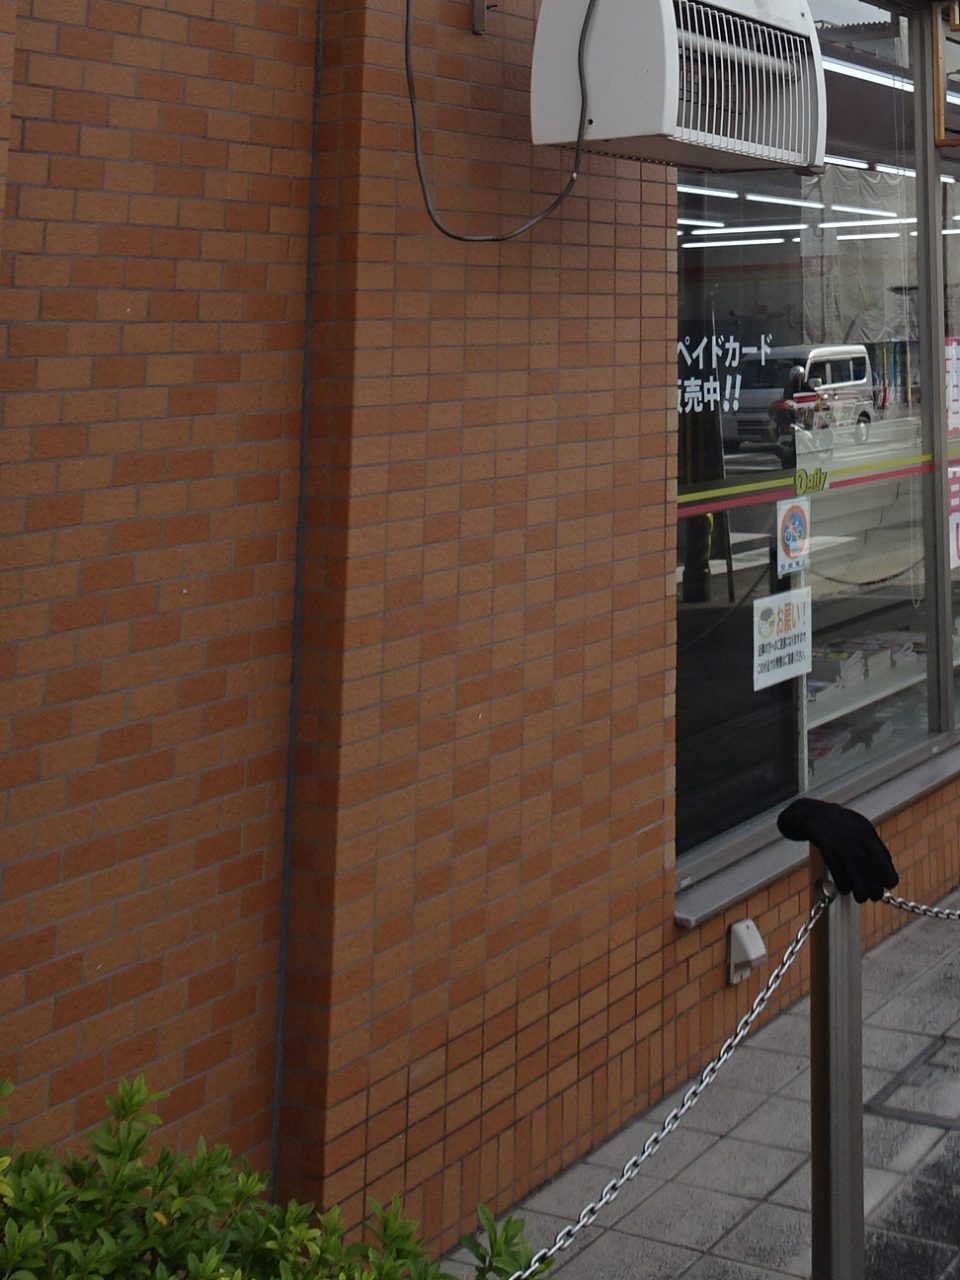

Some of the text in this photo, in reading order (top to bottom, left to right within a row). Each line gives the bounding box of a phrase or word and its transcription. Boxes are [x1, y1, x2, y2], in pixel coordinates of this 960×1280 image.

[677, 333, 773, 370] ペイドカード
[794, 467, 828, 497] Daily
